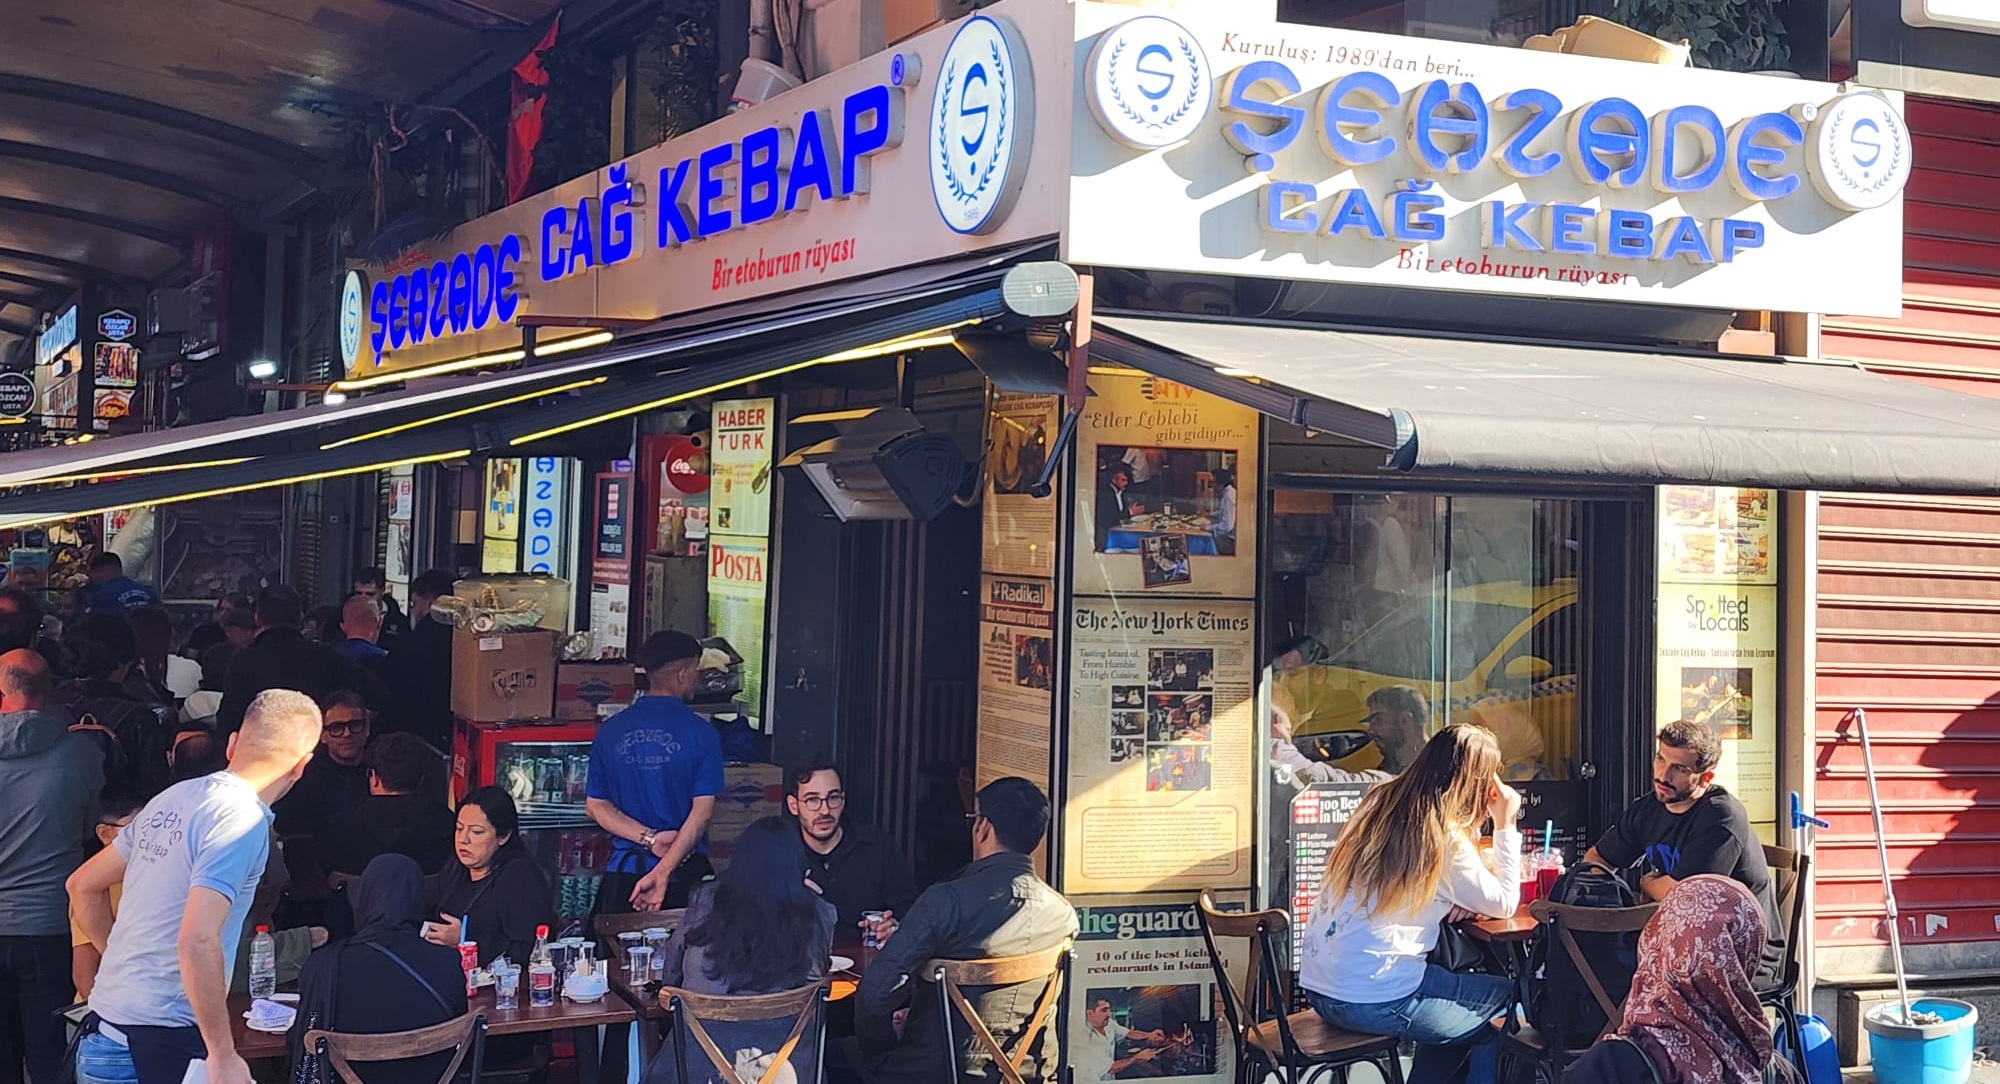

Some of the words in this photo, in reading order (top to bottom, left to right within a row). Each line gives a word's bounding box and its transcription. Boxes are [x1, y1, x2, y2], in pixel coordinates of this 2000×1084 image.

[1221, 32, 1317, 64] Kuruluş:
[1325, 45, 1418, 73] 1989'dan
[1425, 55, 1475, 78] beri...
[1222, 60, 1805, 199] ŞEHZADE
[370, 233, 521, 368] ŞEHZADE
[540, 167, 633, 282] CAĞ
[657, 84, 890, 248] KEBAP
[1491, 199, 1766, 265] KEBAP
[712, 258, 734, 291] Bir
[736, 248, 803, 285] etoburun
[804, 237, 857, 273] rüyası
[1397, 248, 1435, 271] Bir
[1440, 253, 1550, 280] etoburun
[1558, 262, 1629, 287] rüyası
[718, 408, 766, 428] HABER
[1135, 408, 1199, 430] Leblebi
[718, 432, 765, 451] TURK
[1155, 427, 1182, 445] gibi
[711, 543, 763, 583] POSTA
[1000, 581, 1044, 604] Radikal
[1075, 608, 1108, 631] The
[1111, 610, 1148, 631] New
[1151, 610, 1195, 635] York
[1196, 611, 1250, 632] Times
[1699, 613, 1750, 632] Locals
[1082, 659, 1104, 669] From
[1079, 670, 1089, 679] To
[1090, 670, 1110, 681] High
[1110, 670, 1141, 680] Cuisine
[1320, 799, 1339, 811] 100
[1319, 809, 1331, 823] in
[1332, 809, 1350, 823] the
[1095, 951, 1110, 962] 10
[1114, 950, 1128, 961] of
[1130, 949, 1151, 961] the
[1154, 949, 1180, 960] best
[1087, 963, 1159, 975] restaurants
[1163, 961, 1175, 972] in
